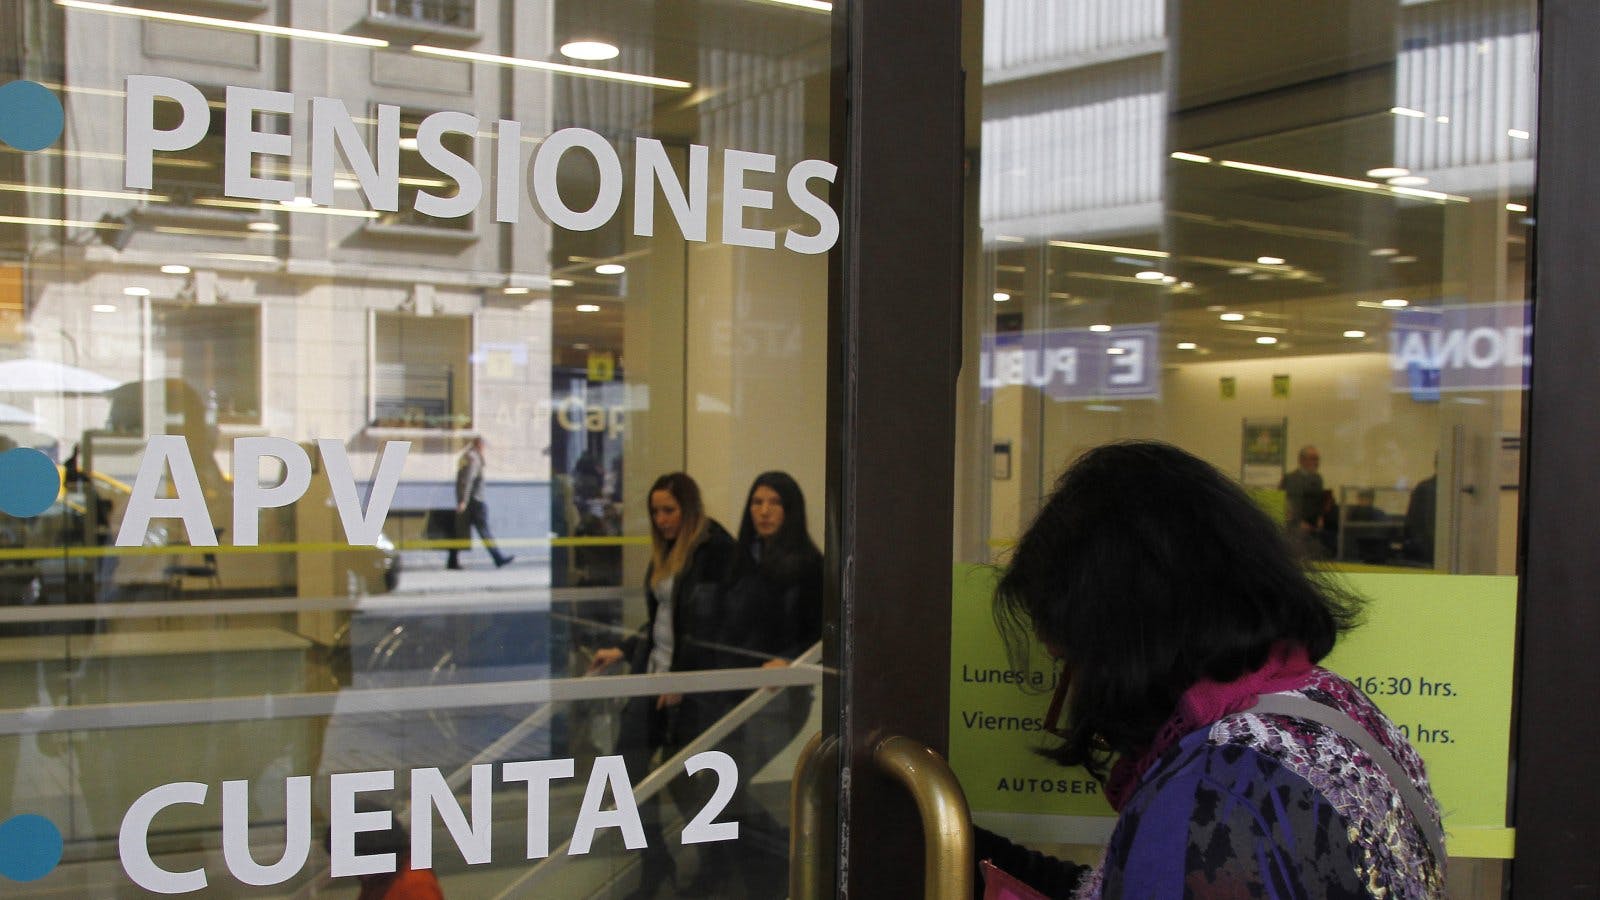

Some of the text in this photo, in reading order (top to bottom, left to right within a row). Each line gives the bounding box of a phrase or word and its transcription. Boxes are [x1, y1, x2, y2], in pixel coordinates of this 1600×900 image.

[125, 74, 841, 255] PENSIONES
[115, 434, 412, 547] APV
[962, 664, 1025, 684] Lunes
[1032, 672, 1044, 685] a
[1354, 676, 1458, 697] 16:30 hrs.
[962, 711, 1043, 732] Viernes
[1417, 724, 1456, 744] hrs.
[996, 777, 1098, 795] AUTOSER
[118, 750, 741, 894] CUENTA 2
